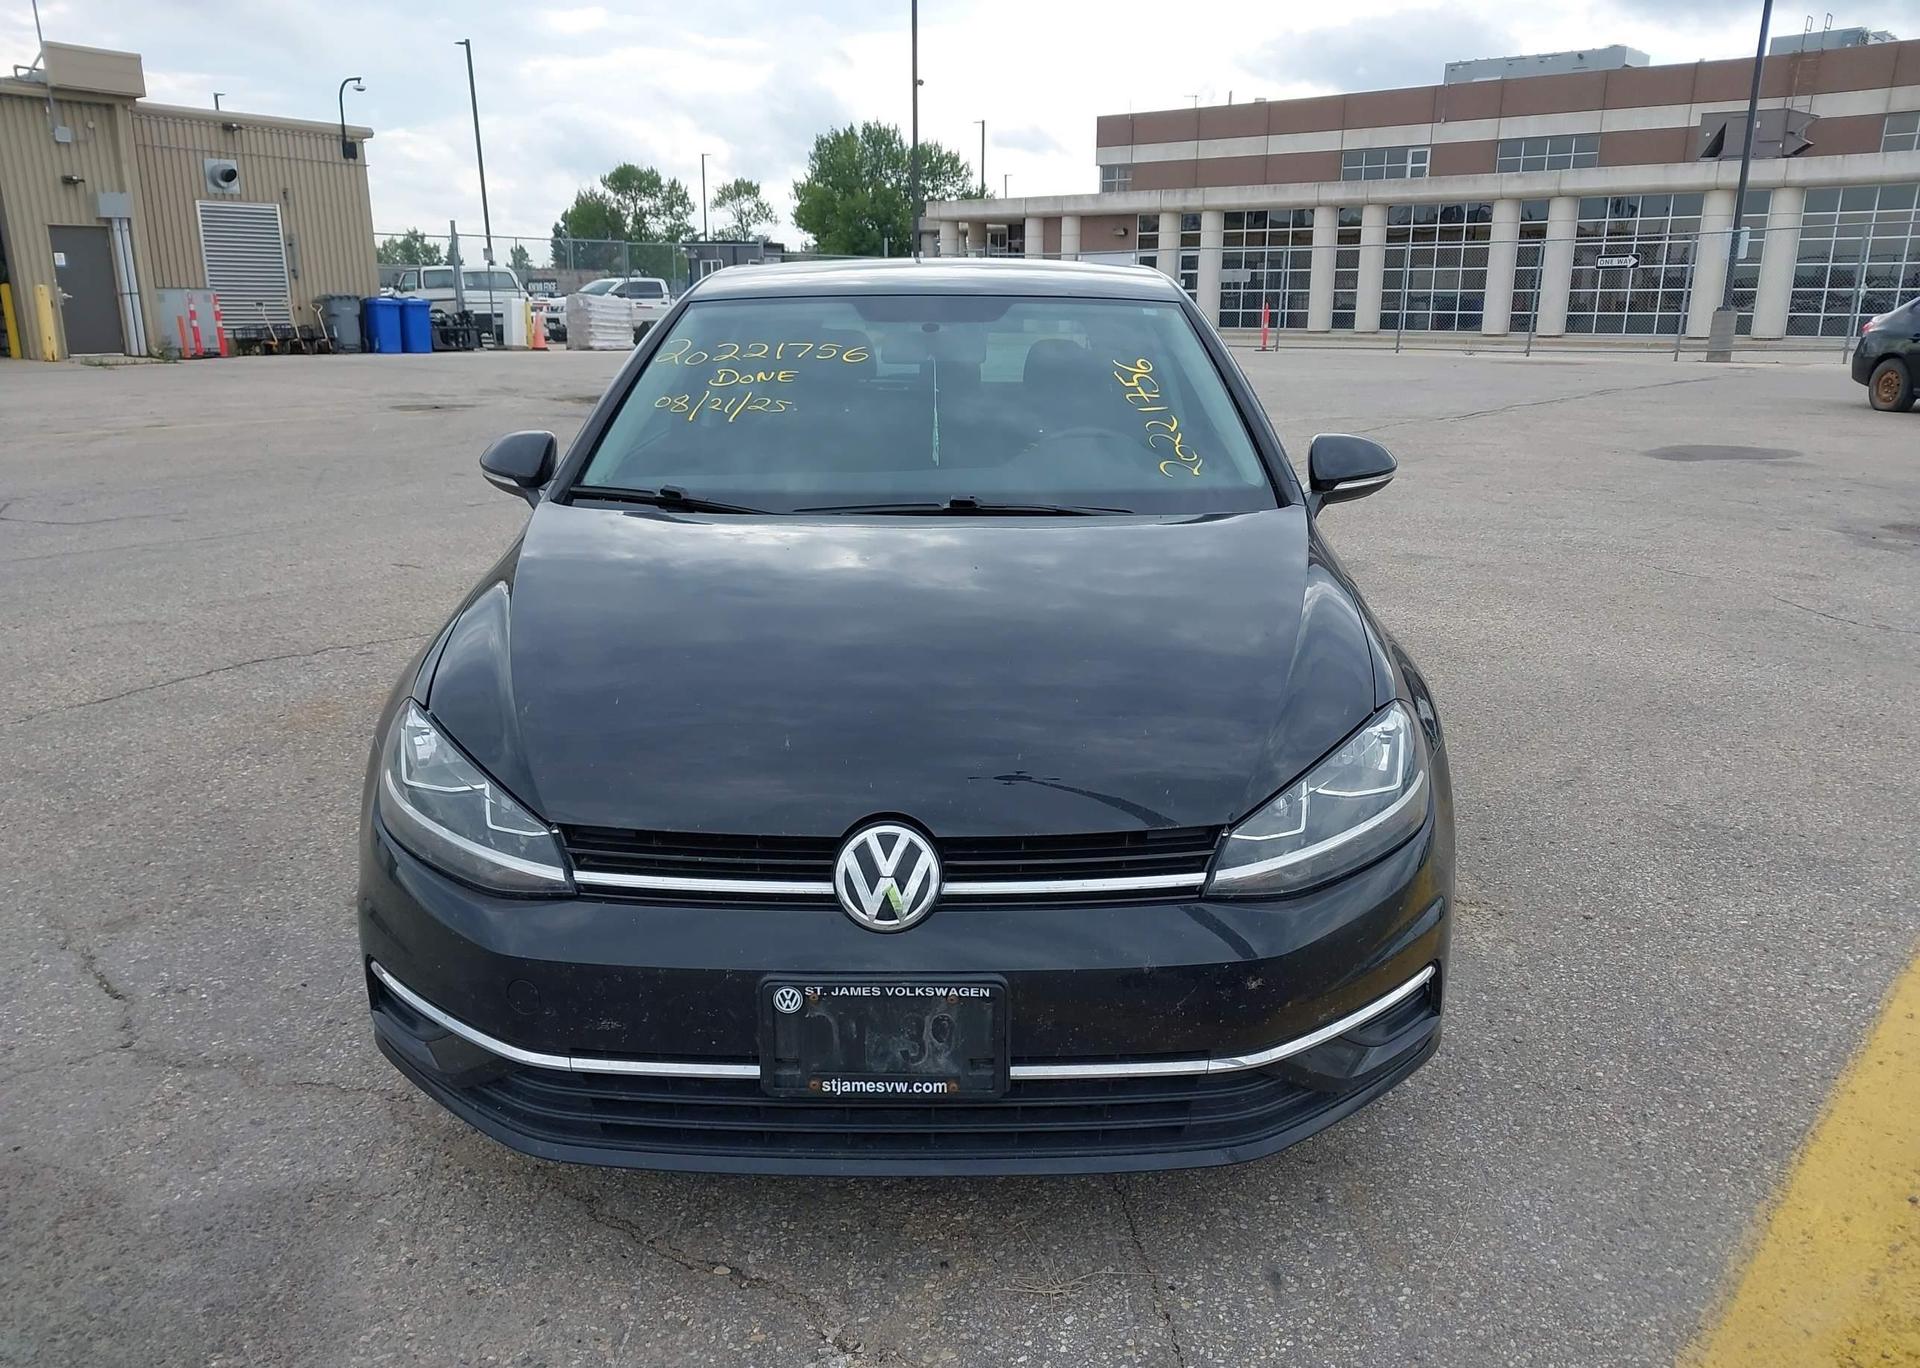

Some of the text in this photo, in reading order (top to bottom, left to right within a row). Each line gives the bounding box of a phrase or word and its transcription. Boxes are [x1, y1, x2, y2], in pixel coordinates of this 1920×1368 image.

[1599, 257, 1633, 266] ONE WAY
[655, 338, 870, 366] 20221756
[708, 368, 799, 387] DONE
[654, 390, 793, 423] 08/21/25
[1112, 358, 1203, 478] 20221756
[804, 986, 990, 998] ST. JAMES VOLKSWAGEN
[821, 1077, 948, 1095] stjamesvw.com
